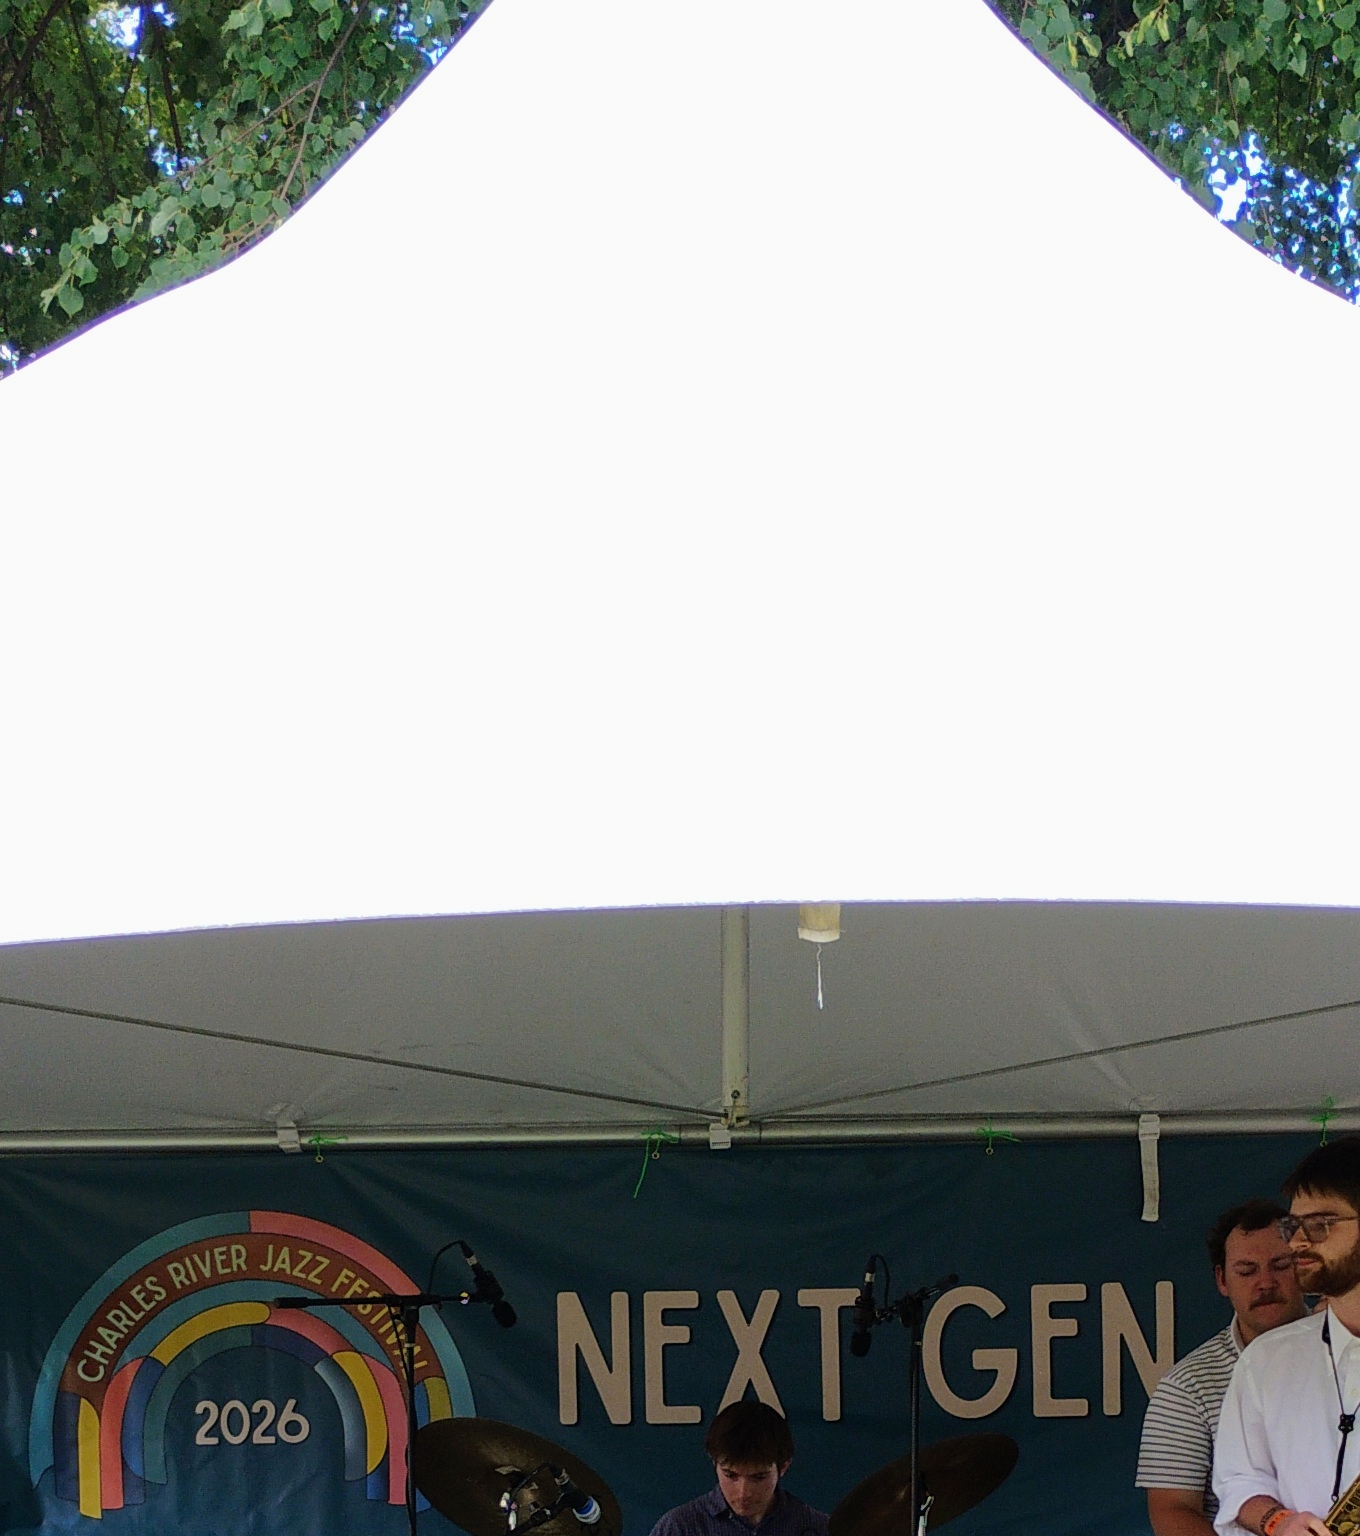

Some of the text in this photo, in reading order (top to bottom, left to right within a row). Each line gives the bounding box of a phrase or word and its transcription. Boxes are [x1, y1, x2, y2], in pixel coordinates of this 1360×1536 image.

[76, 1276, 168, 1383] CHARLES
[167, 1244, 248, 1290] RIVER
[259, 1244, 331, 1286] JAZZ
[557, 1280, 1175, 1425] NEXT GEN
[194, 1398, 310, 1446] 2026
